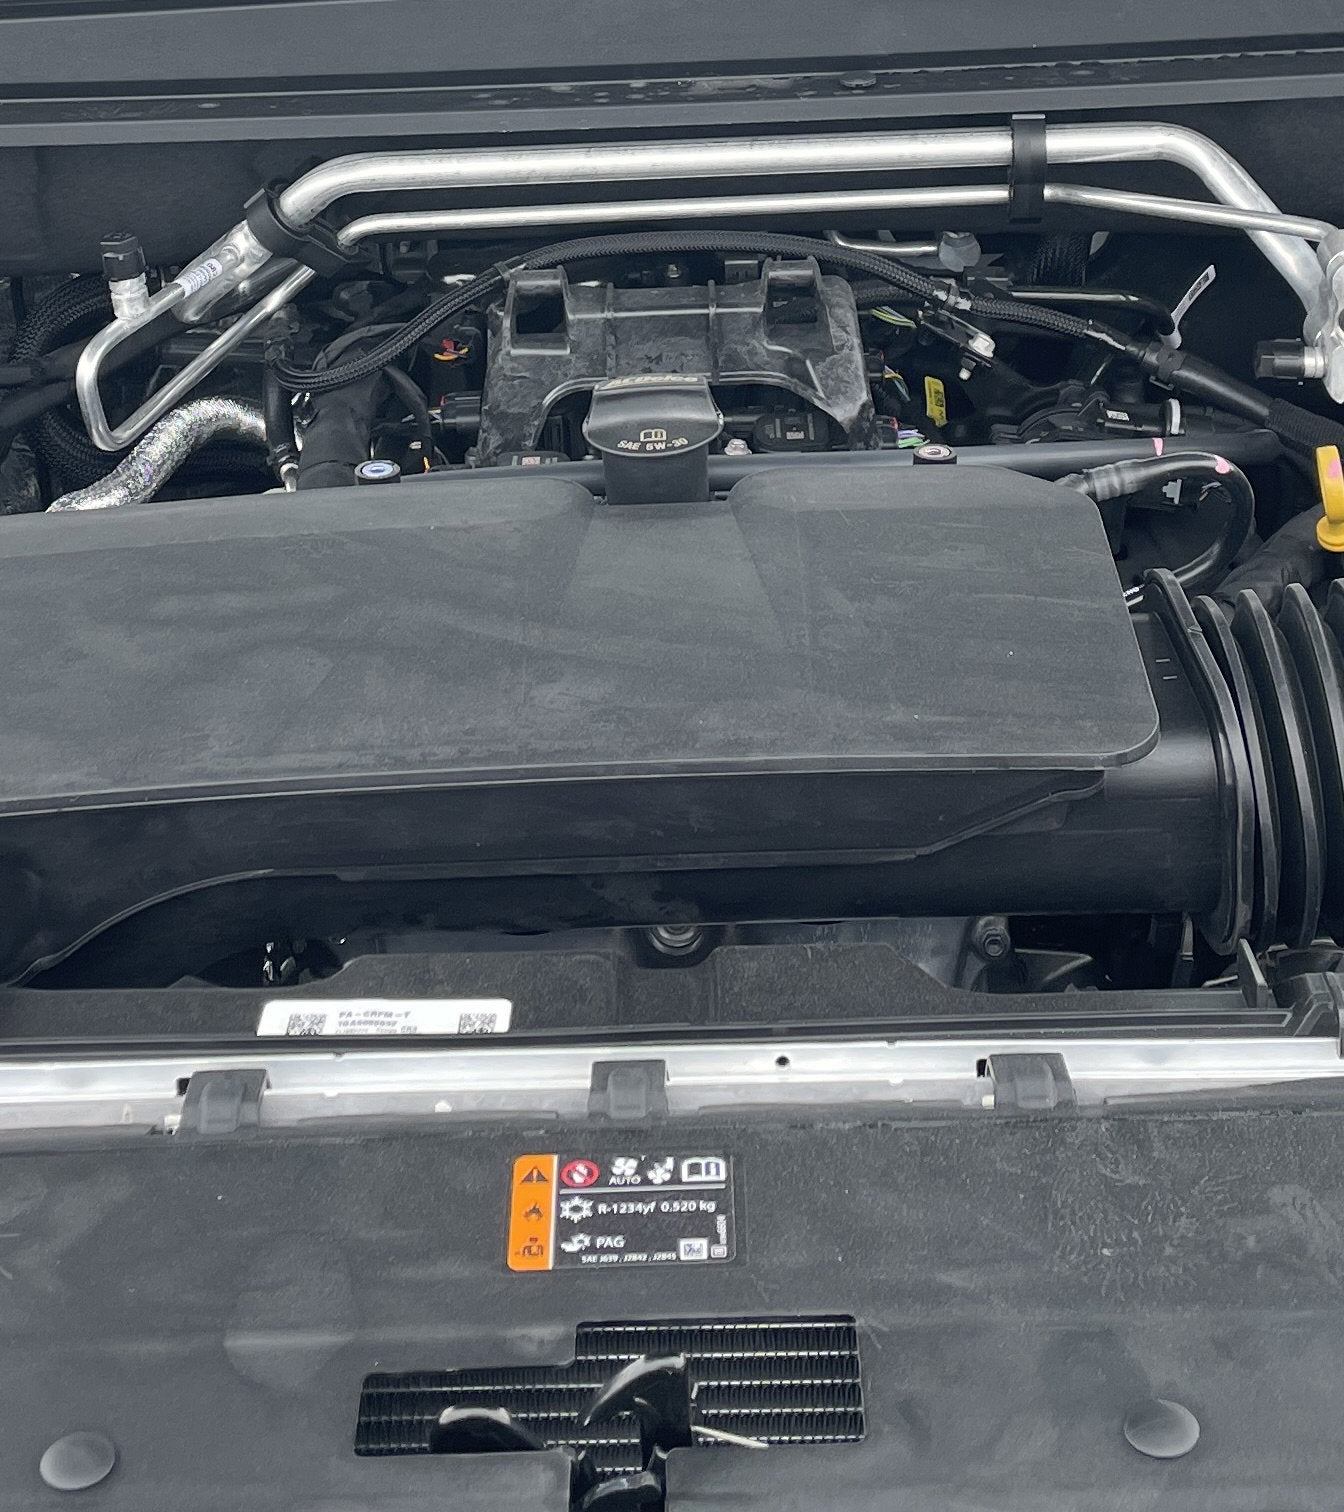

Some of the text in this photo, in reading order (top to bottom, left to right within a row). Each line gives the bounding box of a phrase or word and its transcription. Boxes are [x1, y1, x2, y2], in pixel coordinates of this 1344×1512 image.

[600, 374, 698, 390] ACDelco
[617, 439, 641, 451] SAE
[608, 1176, 642, 1186] AUTO
[598, 1200, 717, 1215] R-1234yf 0.520 kg
[596, 1235, 626, 1249] PAG
[581, 1255, 598, 1264] SAE
